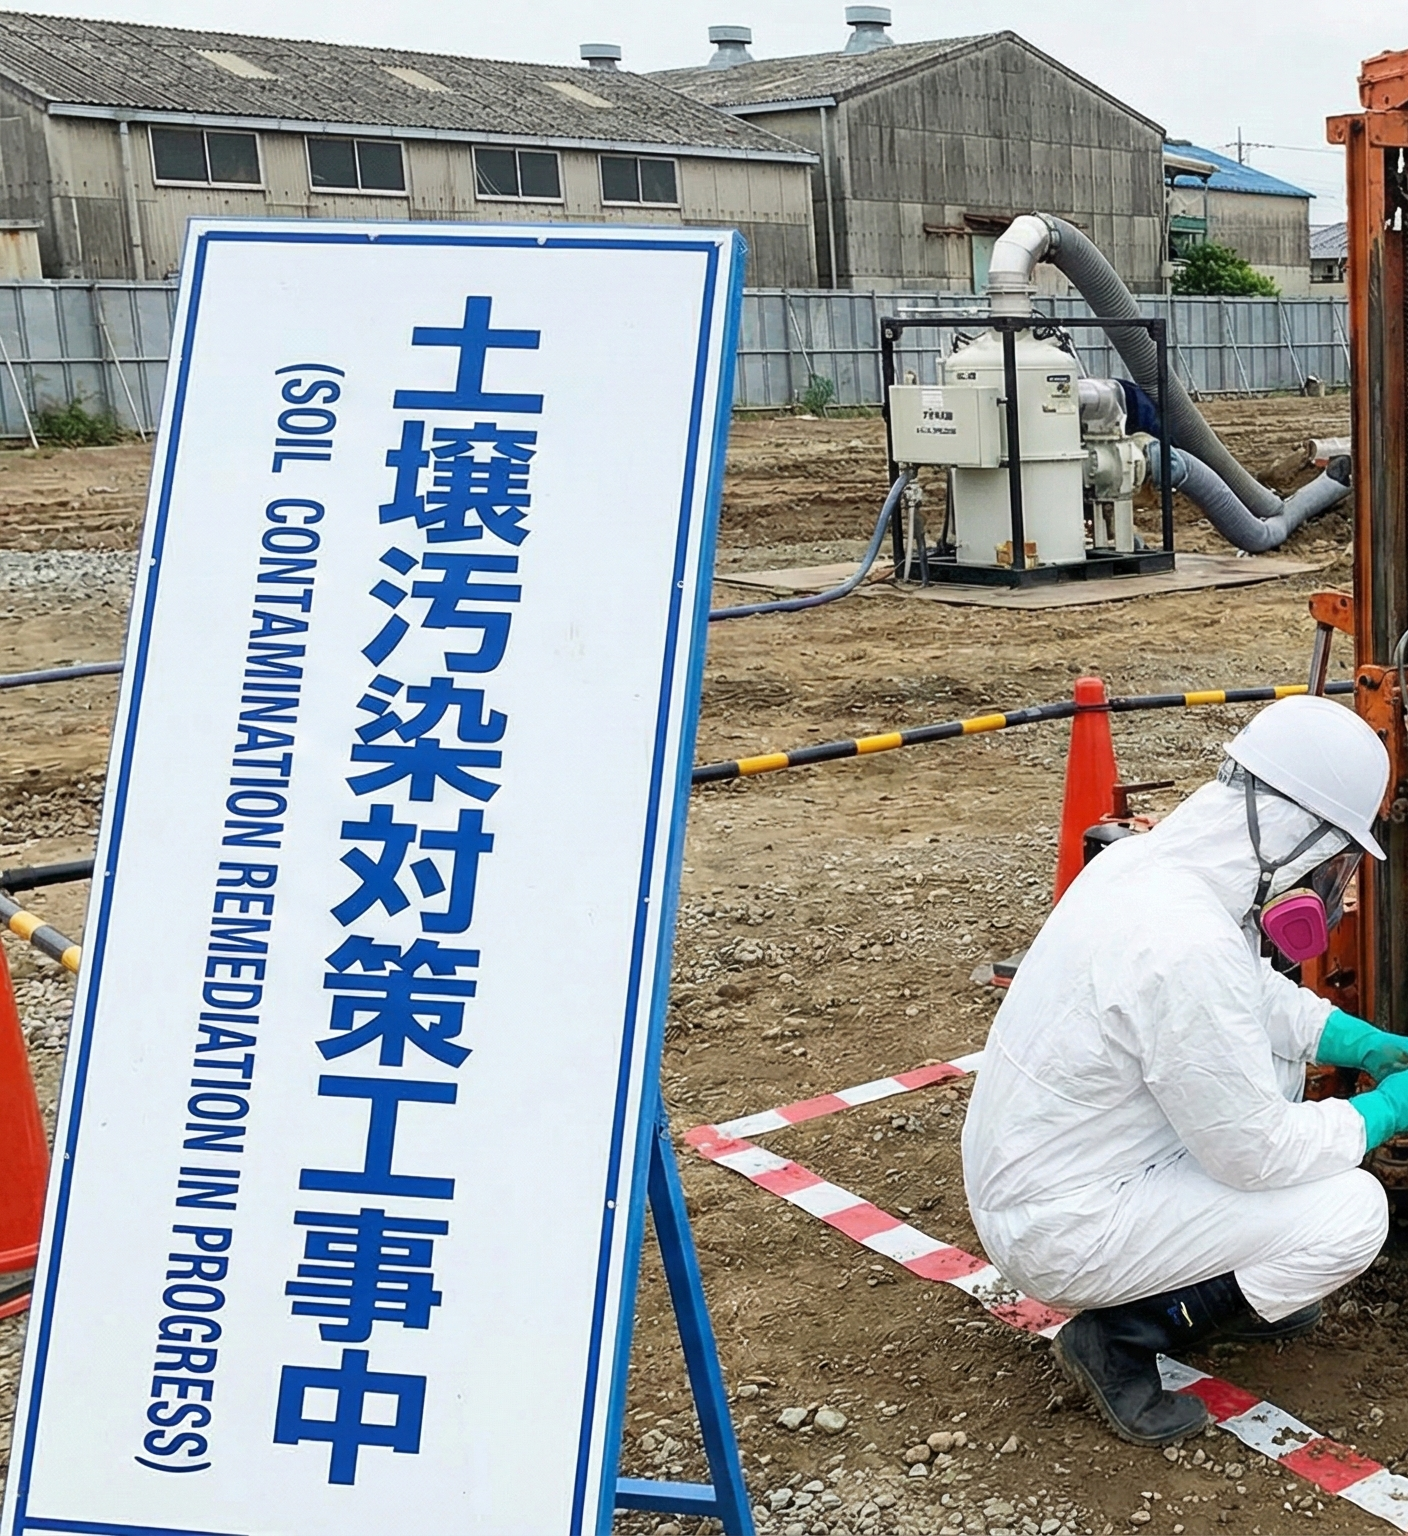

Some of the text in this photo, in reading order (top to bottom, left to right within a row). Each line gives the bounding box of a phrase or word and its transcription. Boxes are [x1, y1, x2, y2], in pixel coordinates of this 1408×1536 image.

[135, 363, 346, 1474] (SOIL CONTAMINATION REMEDIATION IN PROGRESS)
